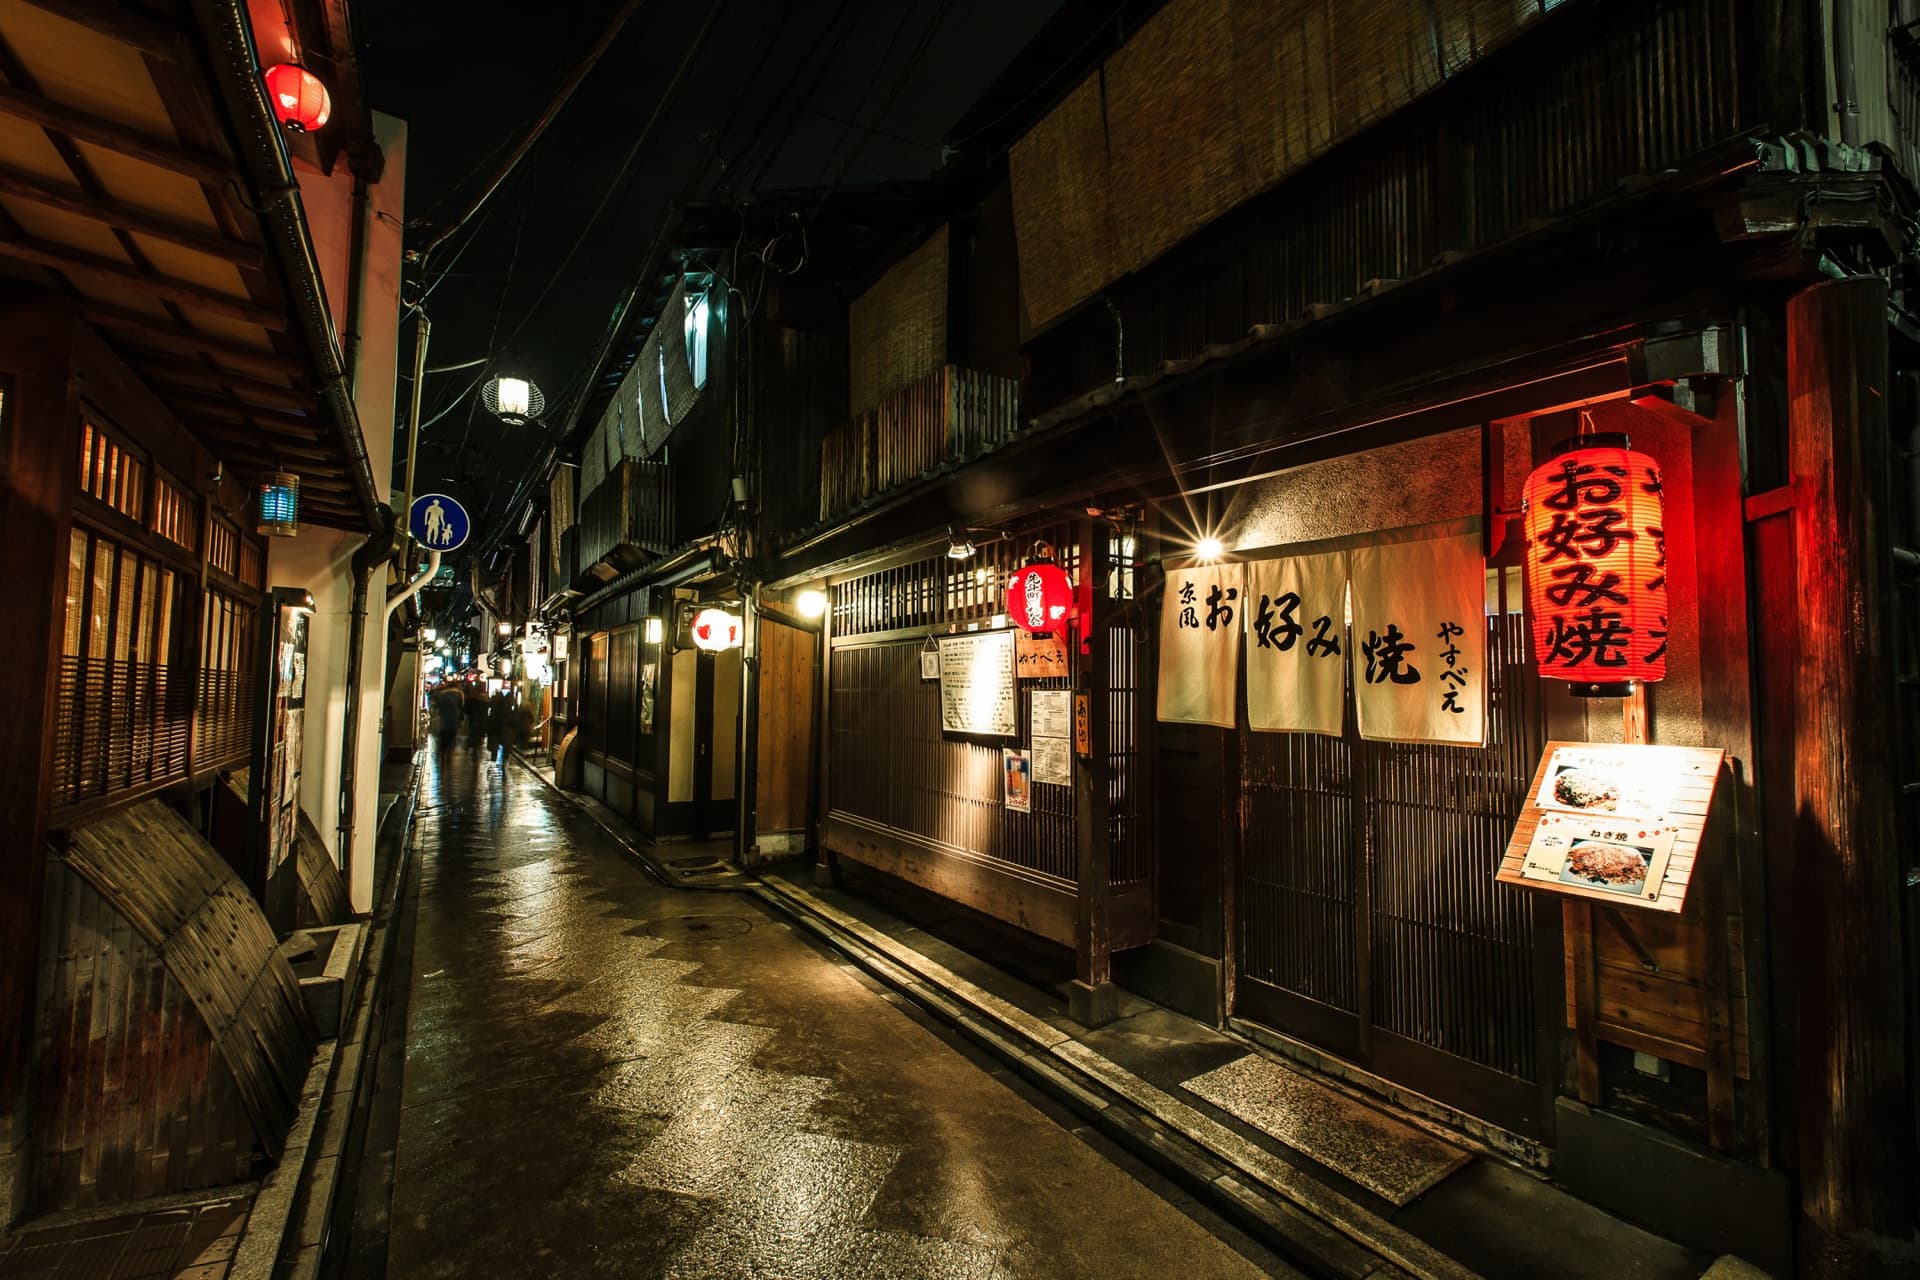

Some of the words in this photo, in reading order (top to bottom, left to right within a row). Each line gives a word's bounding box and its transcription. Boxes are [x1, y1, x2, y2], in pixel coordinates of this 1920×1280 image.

[1178, 580, 1200, 629] 京風
[1538, 460, 1633, 666] お好み焼
[1206, 584, 1420, 685] お好み焼
[1437, 621, 1469, 714] やすべえ
